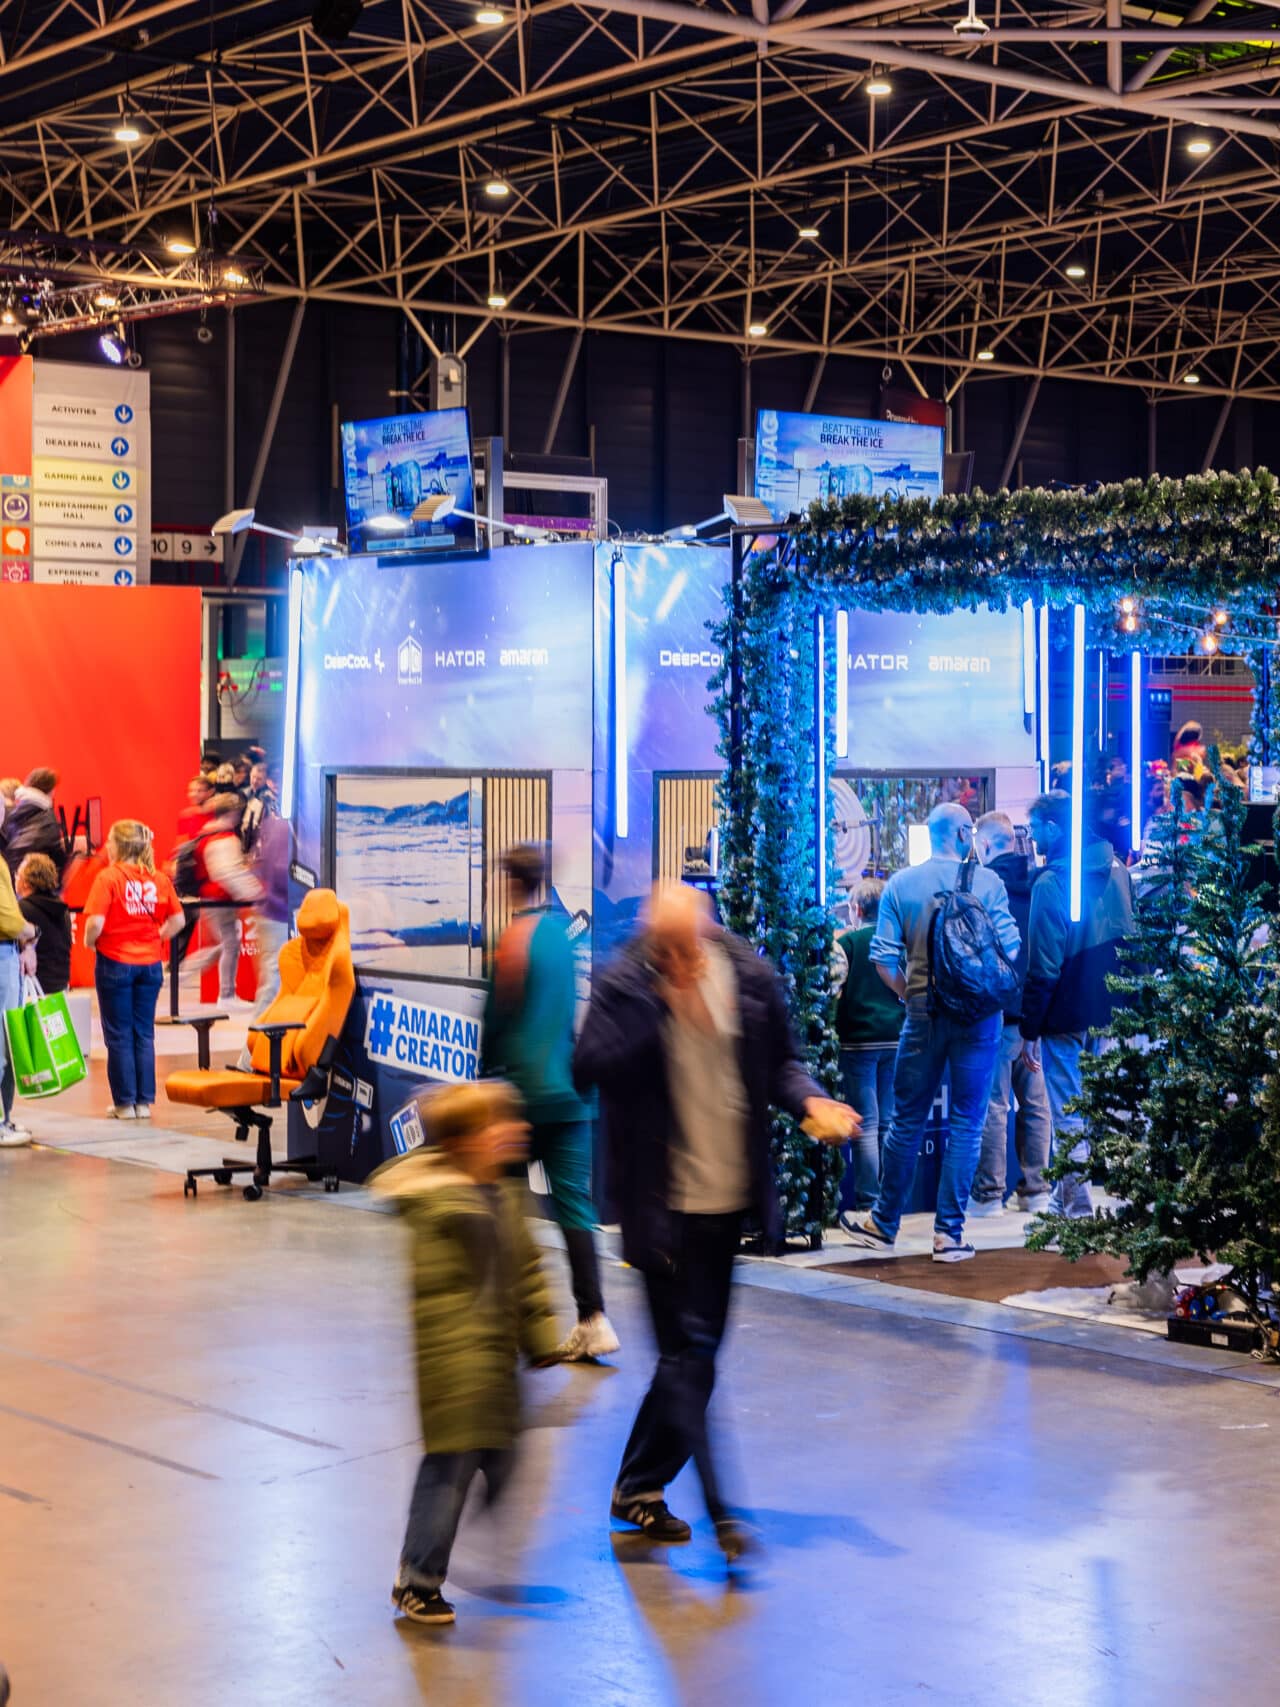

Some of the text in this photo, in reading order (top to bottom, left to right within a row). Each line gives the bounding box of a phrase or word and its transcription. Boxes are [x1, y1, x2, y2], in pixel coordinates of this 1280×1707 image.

[52, 405, 97, 415] ACTIVITIES
[822, 423, 882, 438] BEAT THE TIME
[46, 438, 102, 450] DEALER HALL
[820, 433, 884, 449] BREAK THE ICE
[44, 472, 104, 484] GAMING AREA
[39, 501, 108, 511] ENTERTAINMENT
[63, 512, 84, 520] HALL
[45, 539, 103, 550] COMICS AREA
[152, 538, 168, 554] 10
[182, 539, 192, 555] 9
[48, 569, 99, 577] EXPERIENCE
[435, 650, 486, 667] HATOR
[499, 648, 549, 667] amaran
[927, 654, 991, 673] amaran
